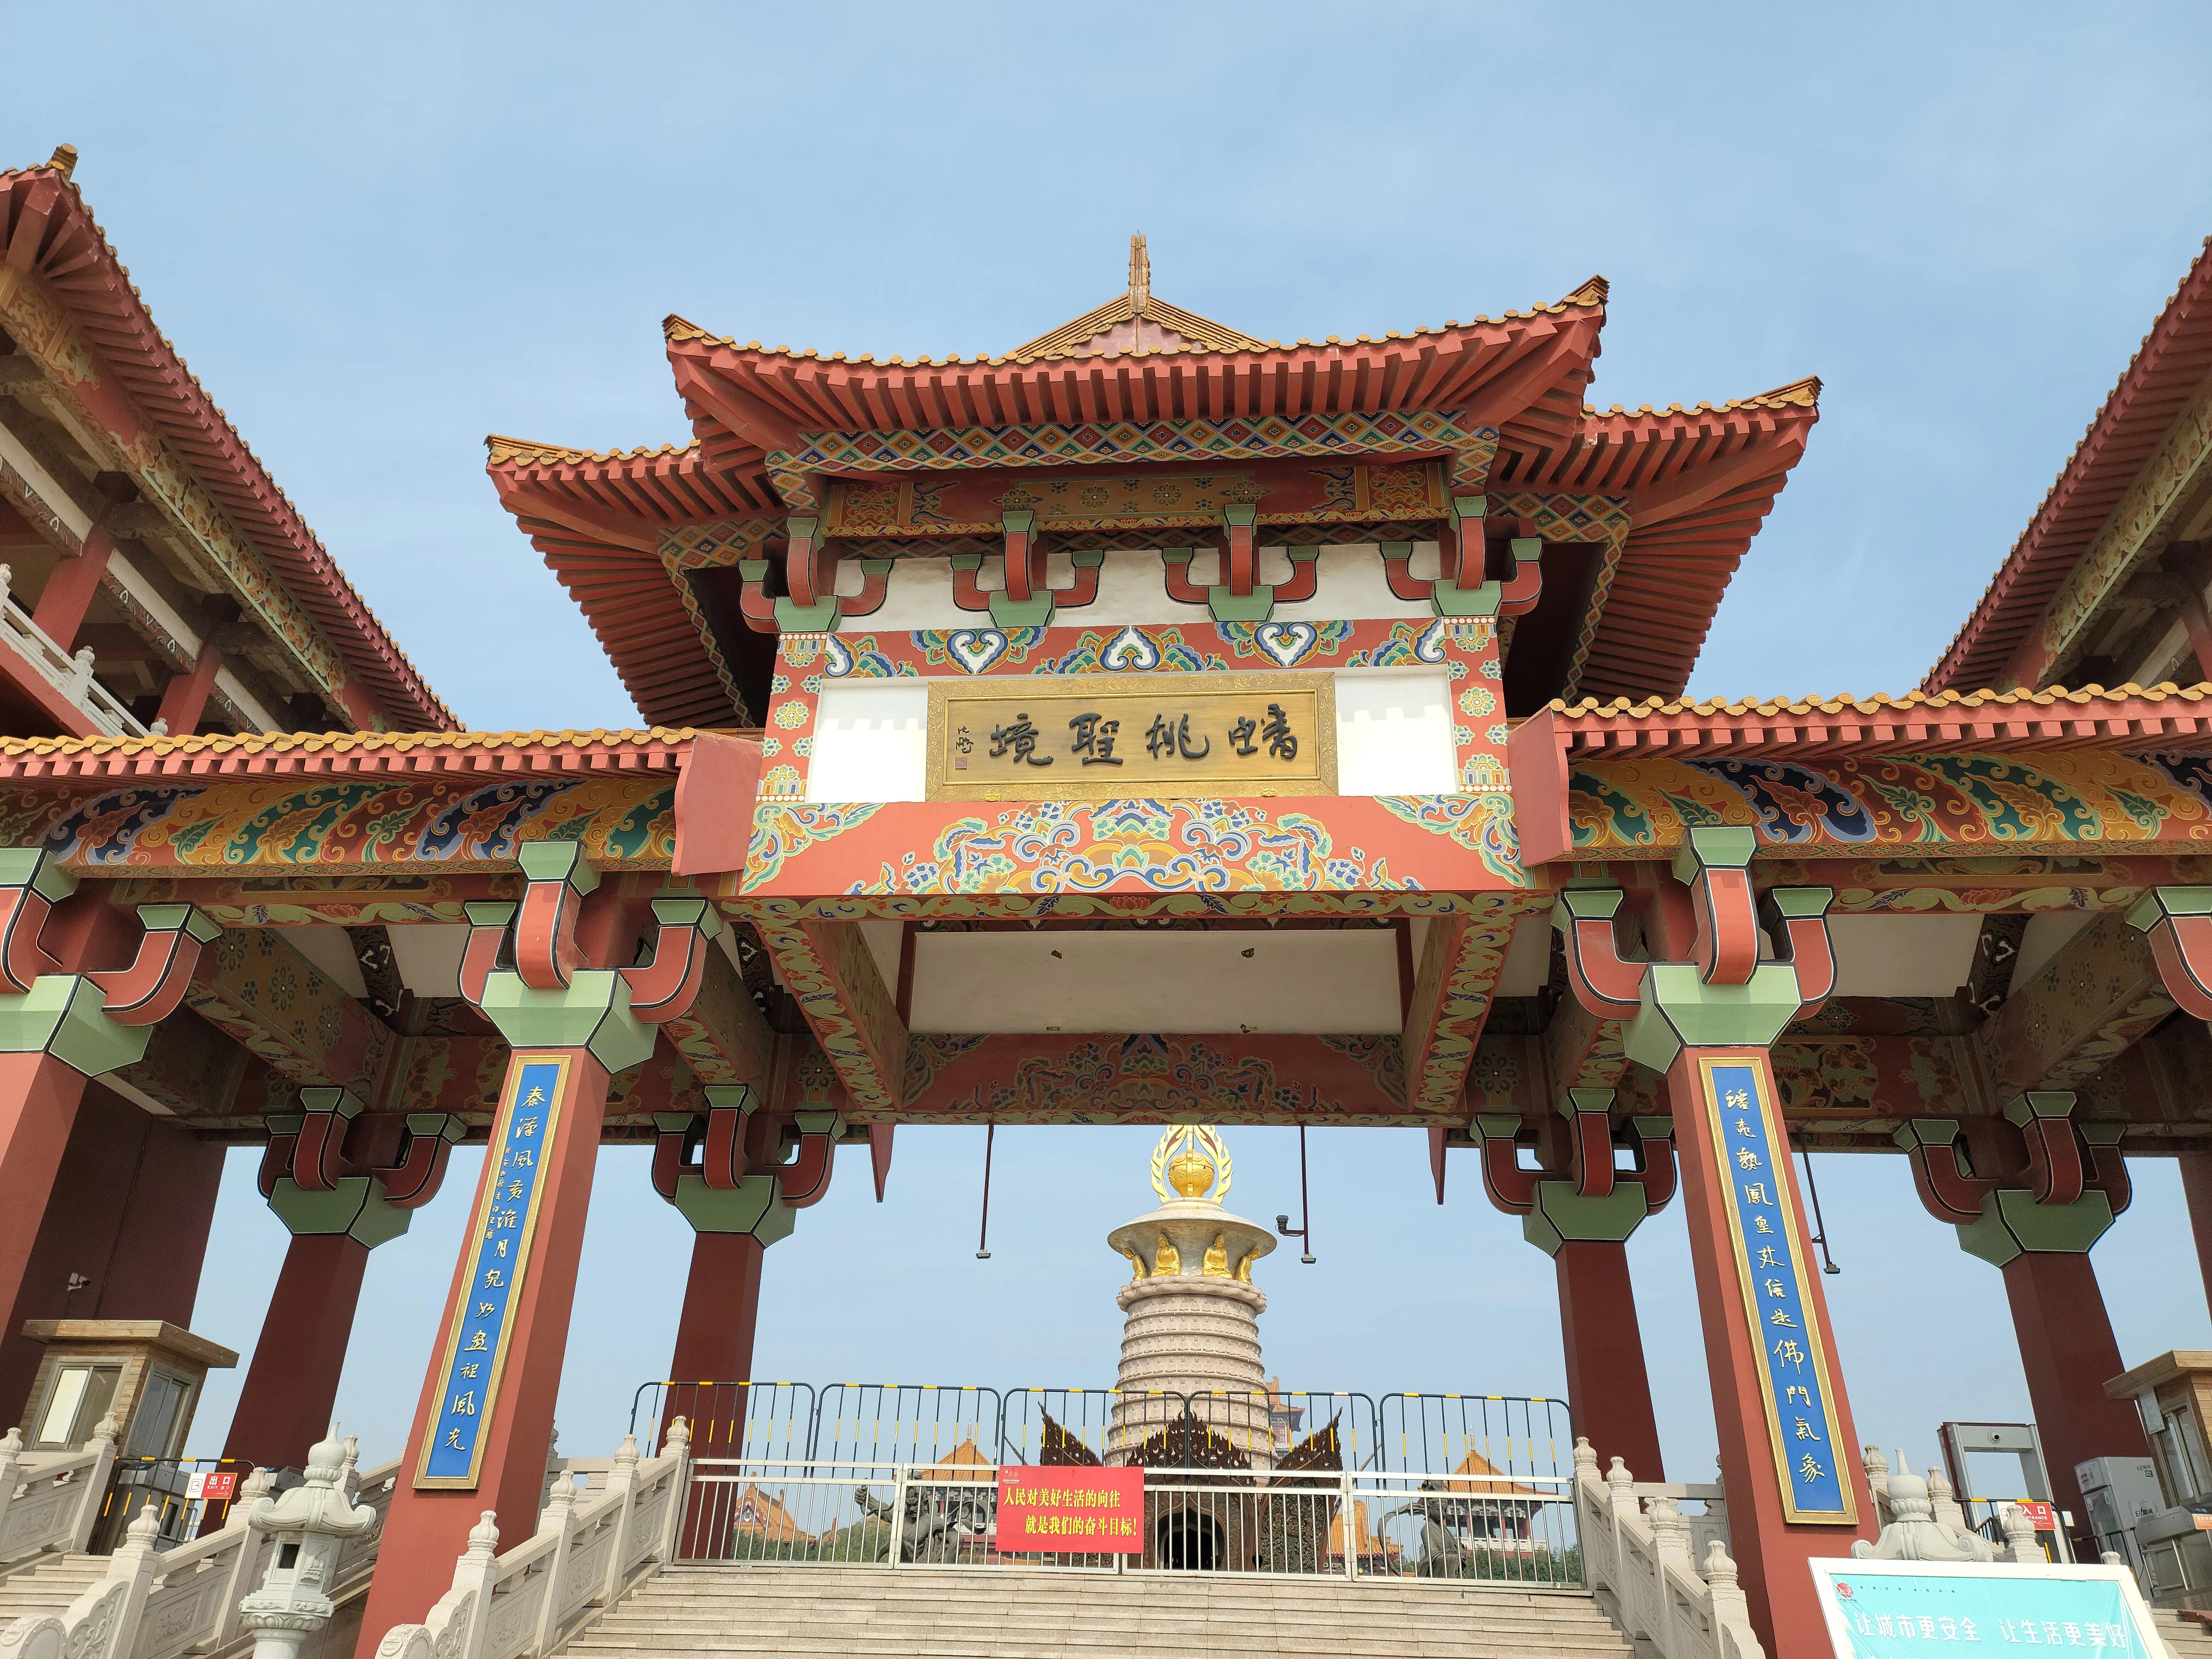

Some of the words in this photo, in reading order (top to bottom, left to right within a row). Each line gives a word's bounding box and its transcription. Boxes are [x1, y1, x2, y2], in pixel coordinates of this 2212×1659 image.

[209, 1475, 231, 1485] 出口
[1003, 1487, 1121, 1508] 人民对美好生活的向往
[2023, 1505, 2046, 1515] 入口
[1854, 1611, 1982, 1641] 让城市更安全
[1998, 1618, 2127, 1649] 让生活更美好
